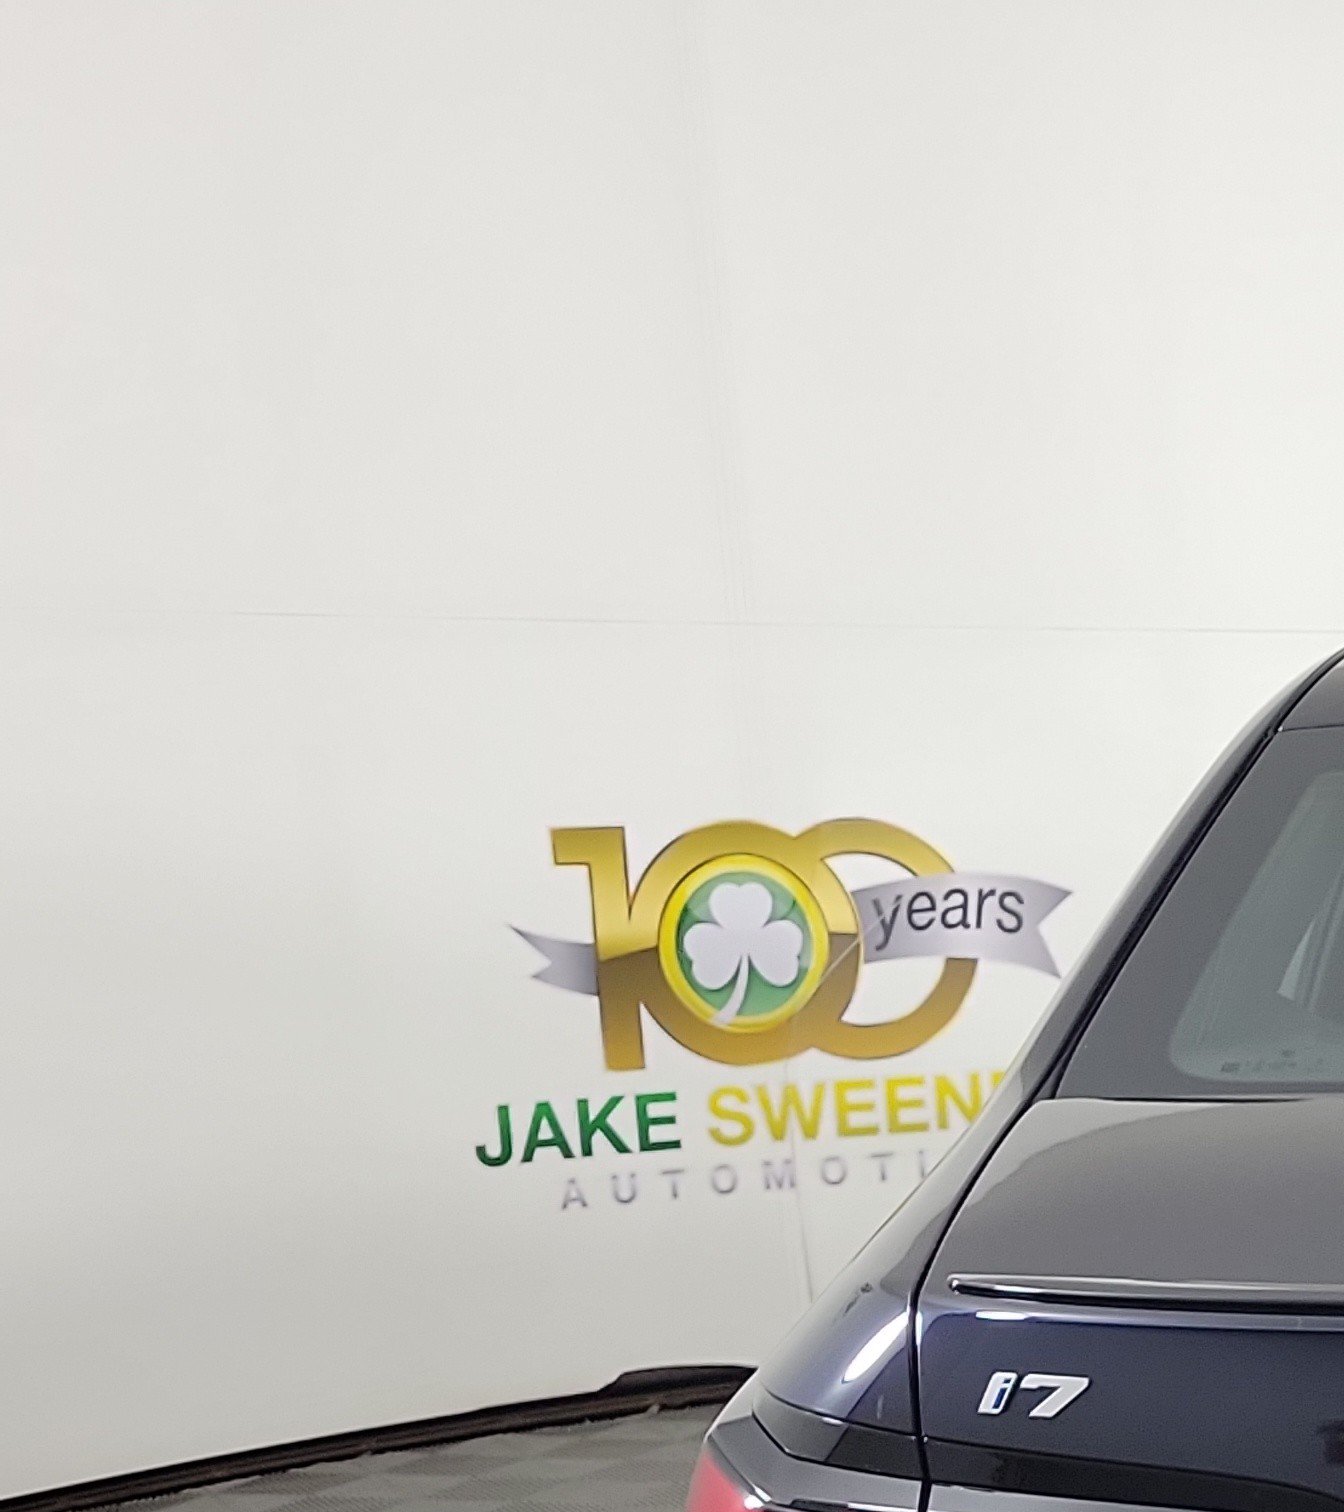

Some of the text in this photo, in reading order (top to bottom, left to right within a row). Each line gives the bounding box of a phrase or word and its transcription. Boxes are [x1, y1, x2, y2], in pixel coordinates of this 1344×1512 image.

[550, 817, 979, 1071] 100
[871, 887, 1026, 951] years
[475, 1069, 1006, 1168] JAKE SWEEN
[561, 1149, 928, 1211] AUTOMOTI
[977, 1371, 1091, 1418] i7
